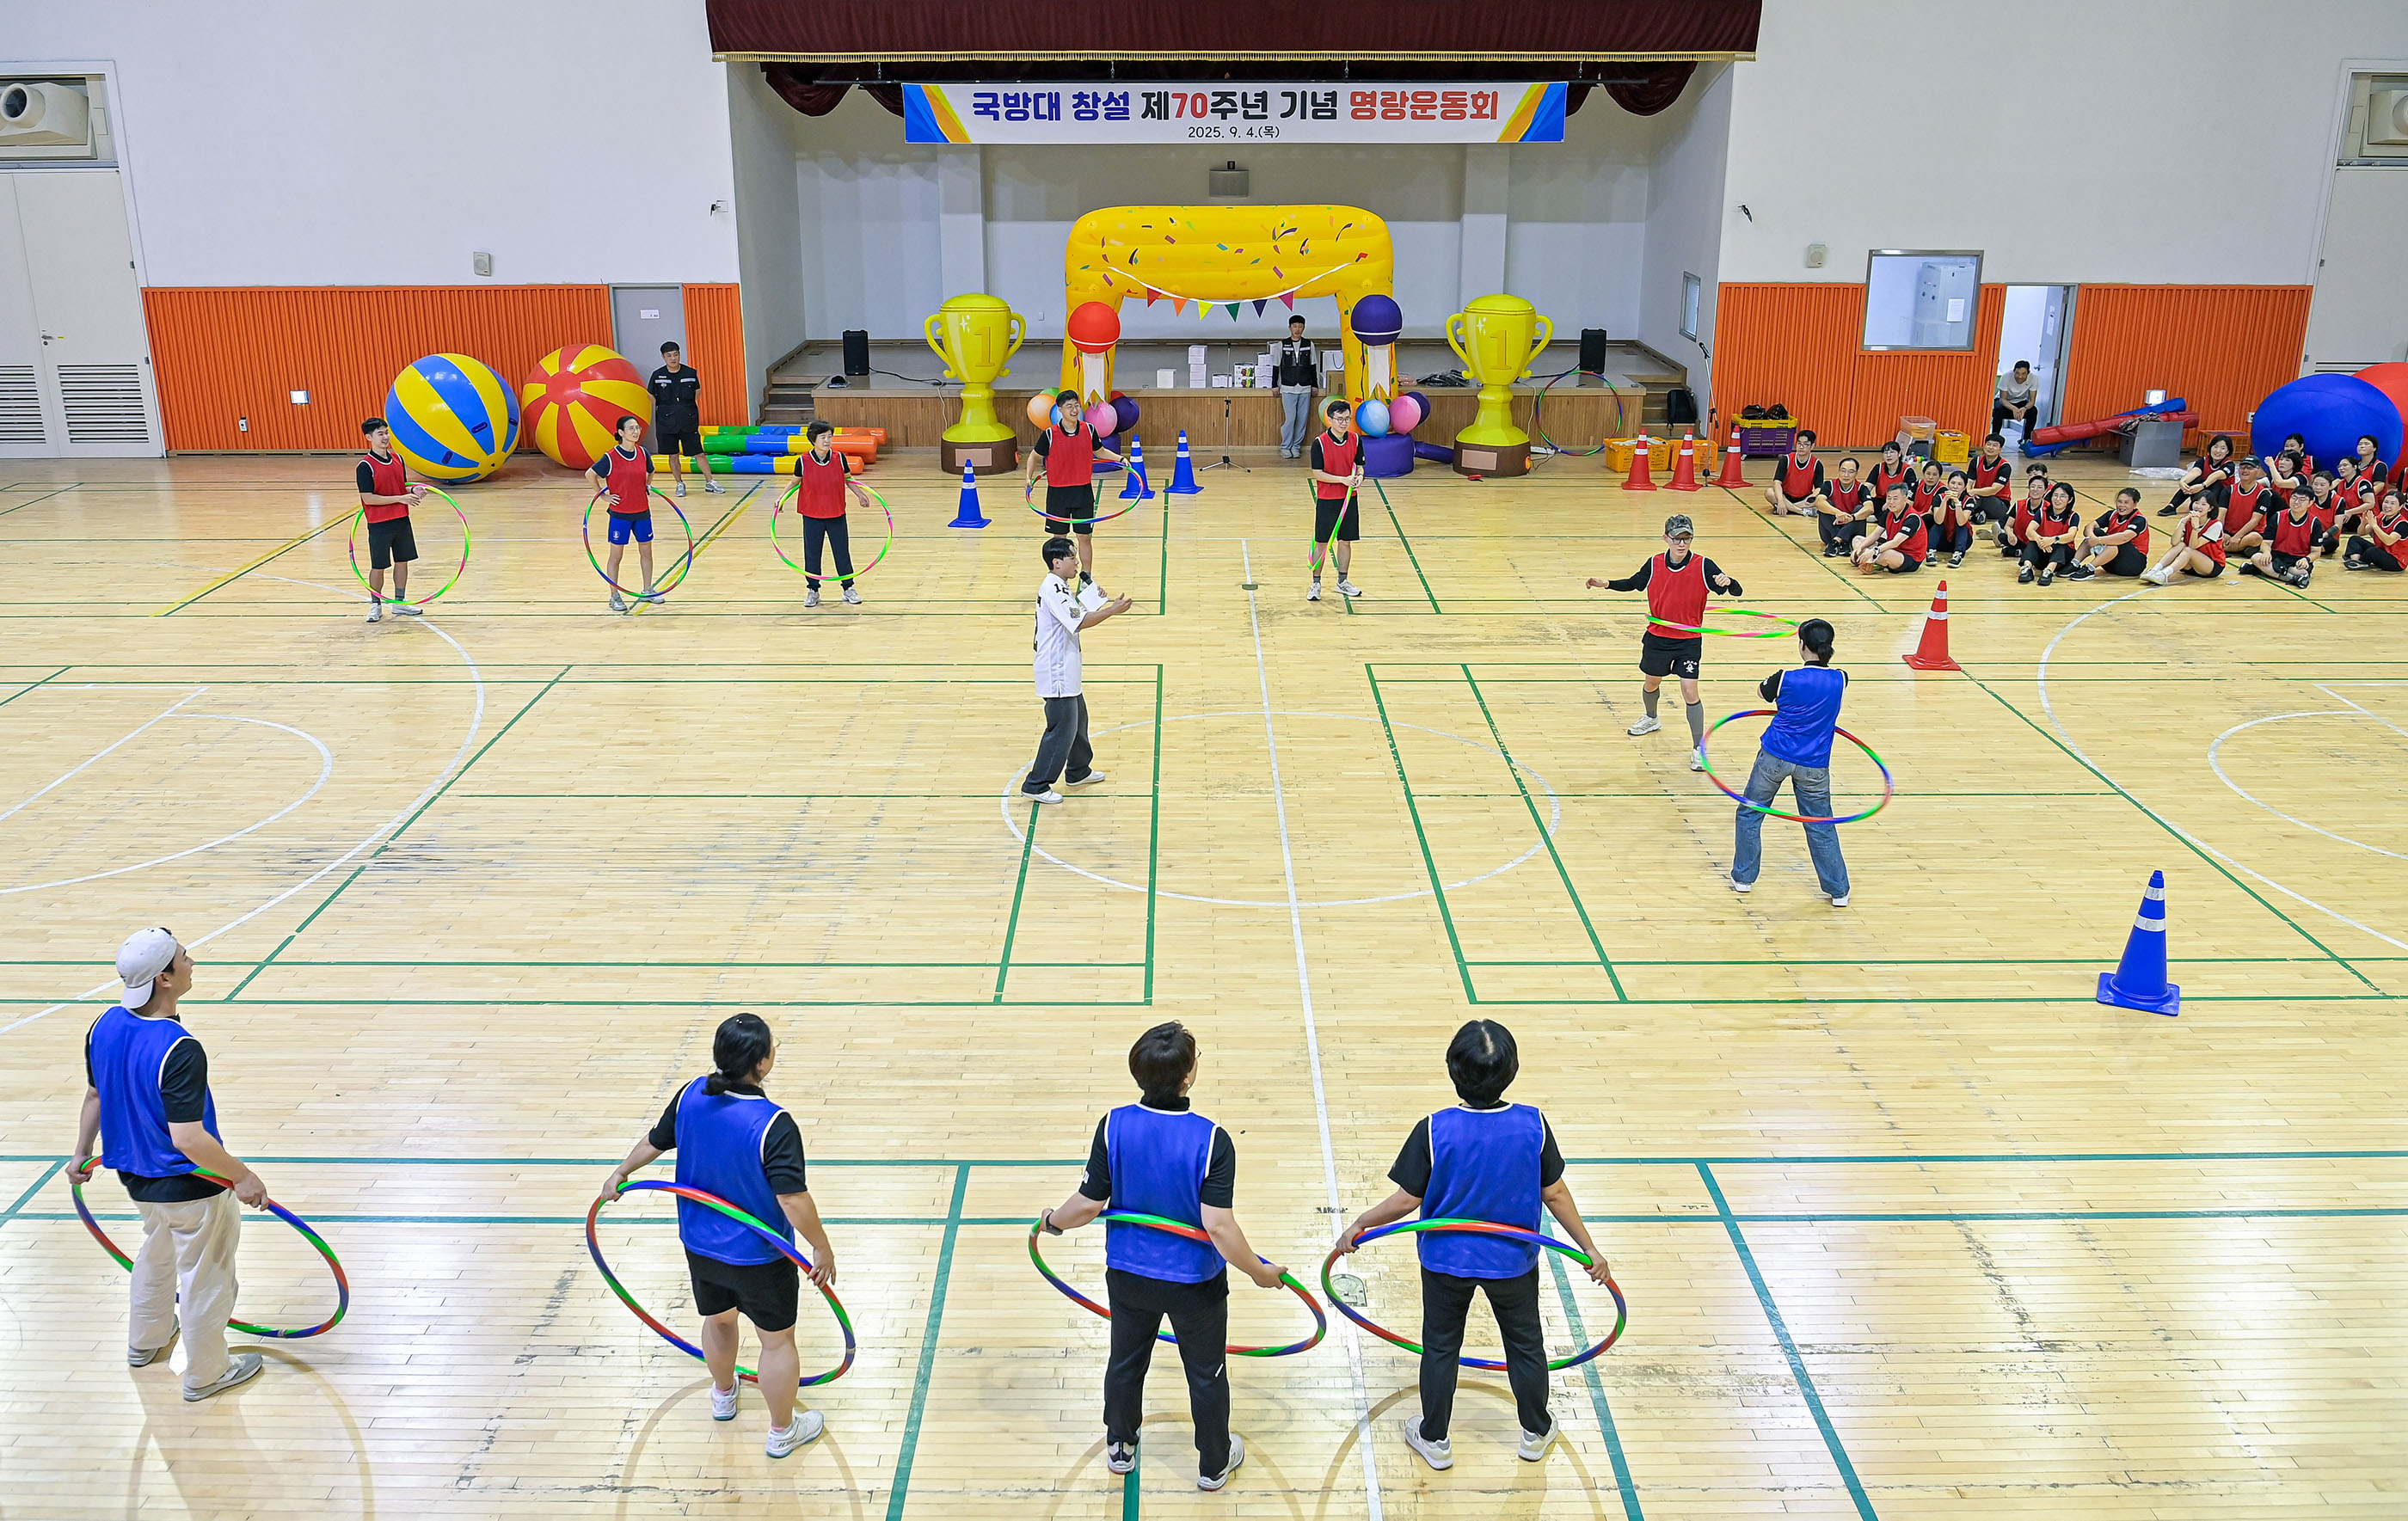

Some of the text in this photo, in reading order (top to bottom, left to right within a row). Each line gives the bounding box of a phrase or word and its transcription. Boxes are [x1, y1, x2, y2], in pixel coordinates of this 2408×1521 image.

[972, 90, 1499, 122] 국방대 창설 제70주년 기념 명랑운동회
[1188, 126, 1280, 138] 2025. 9. 4.(목)
